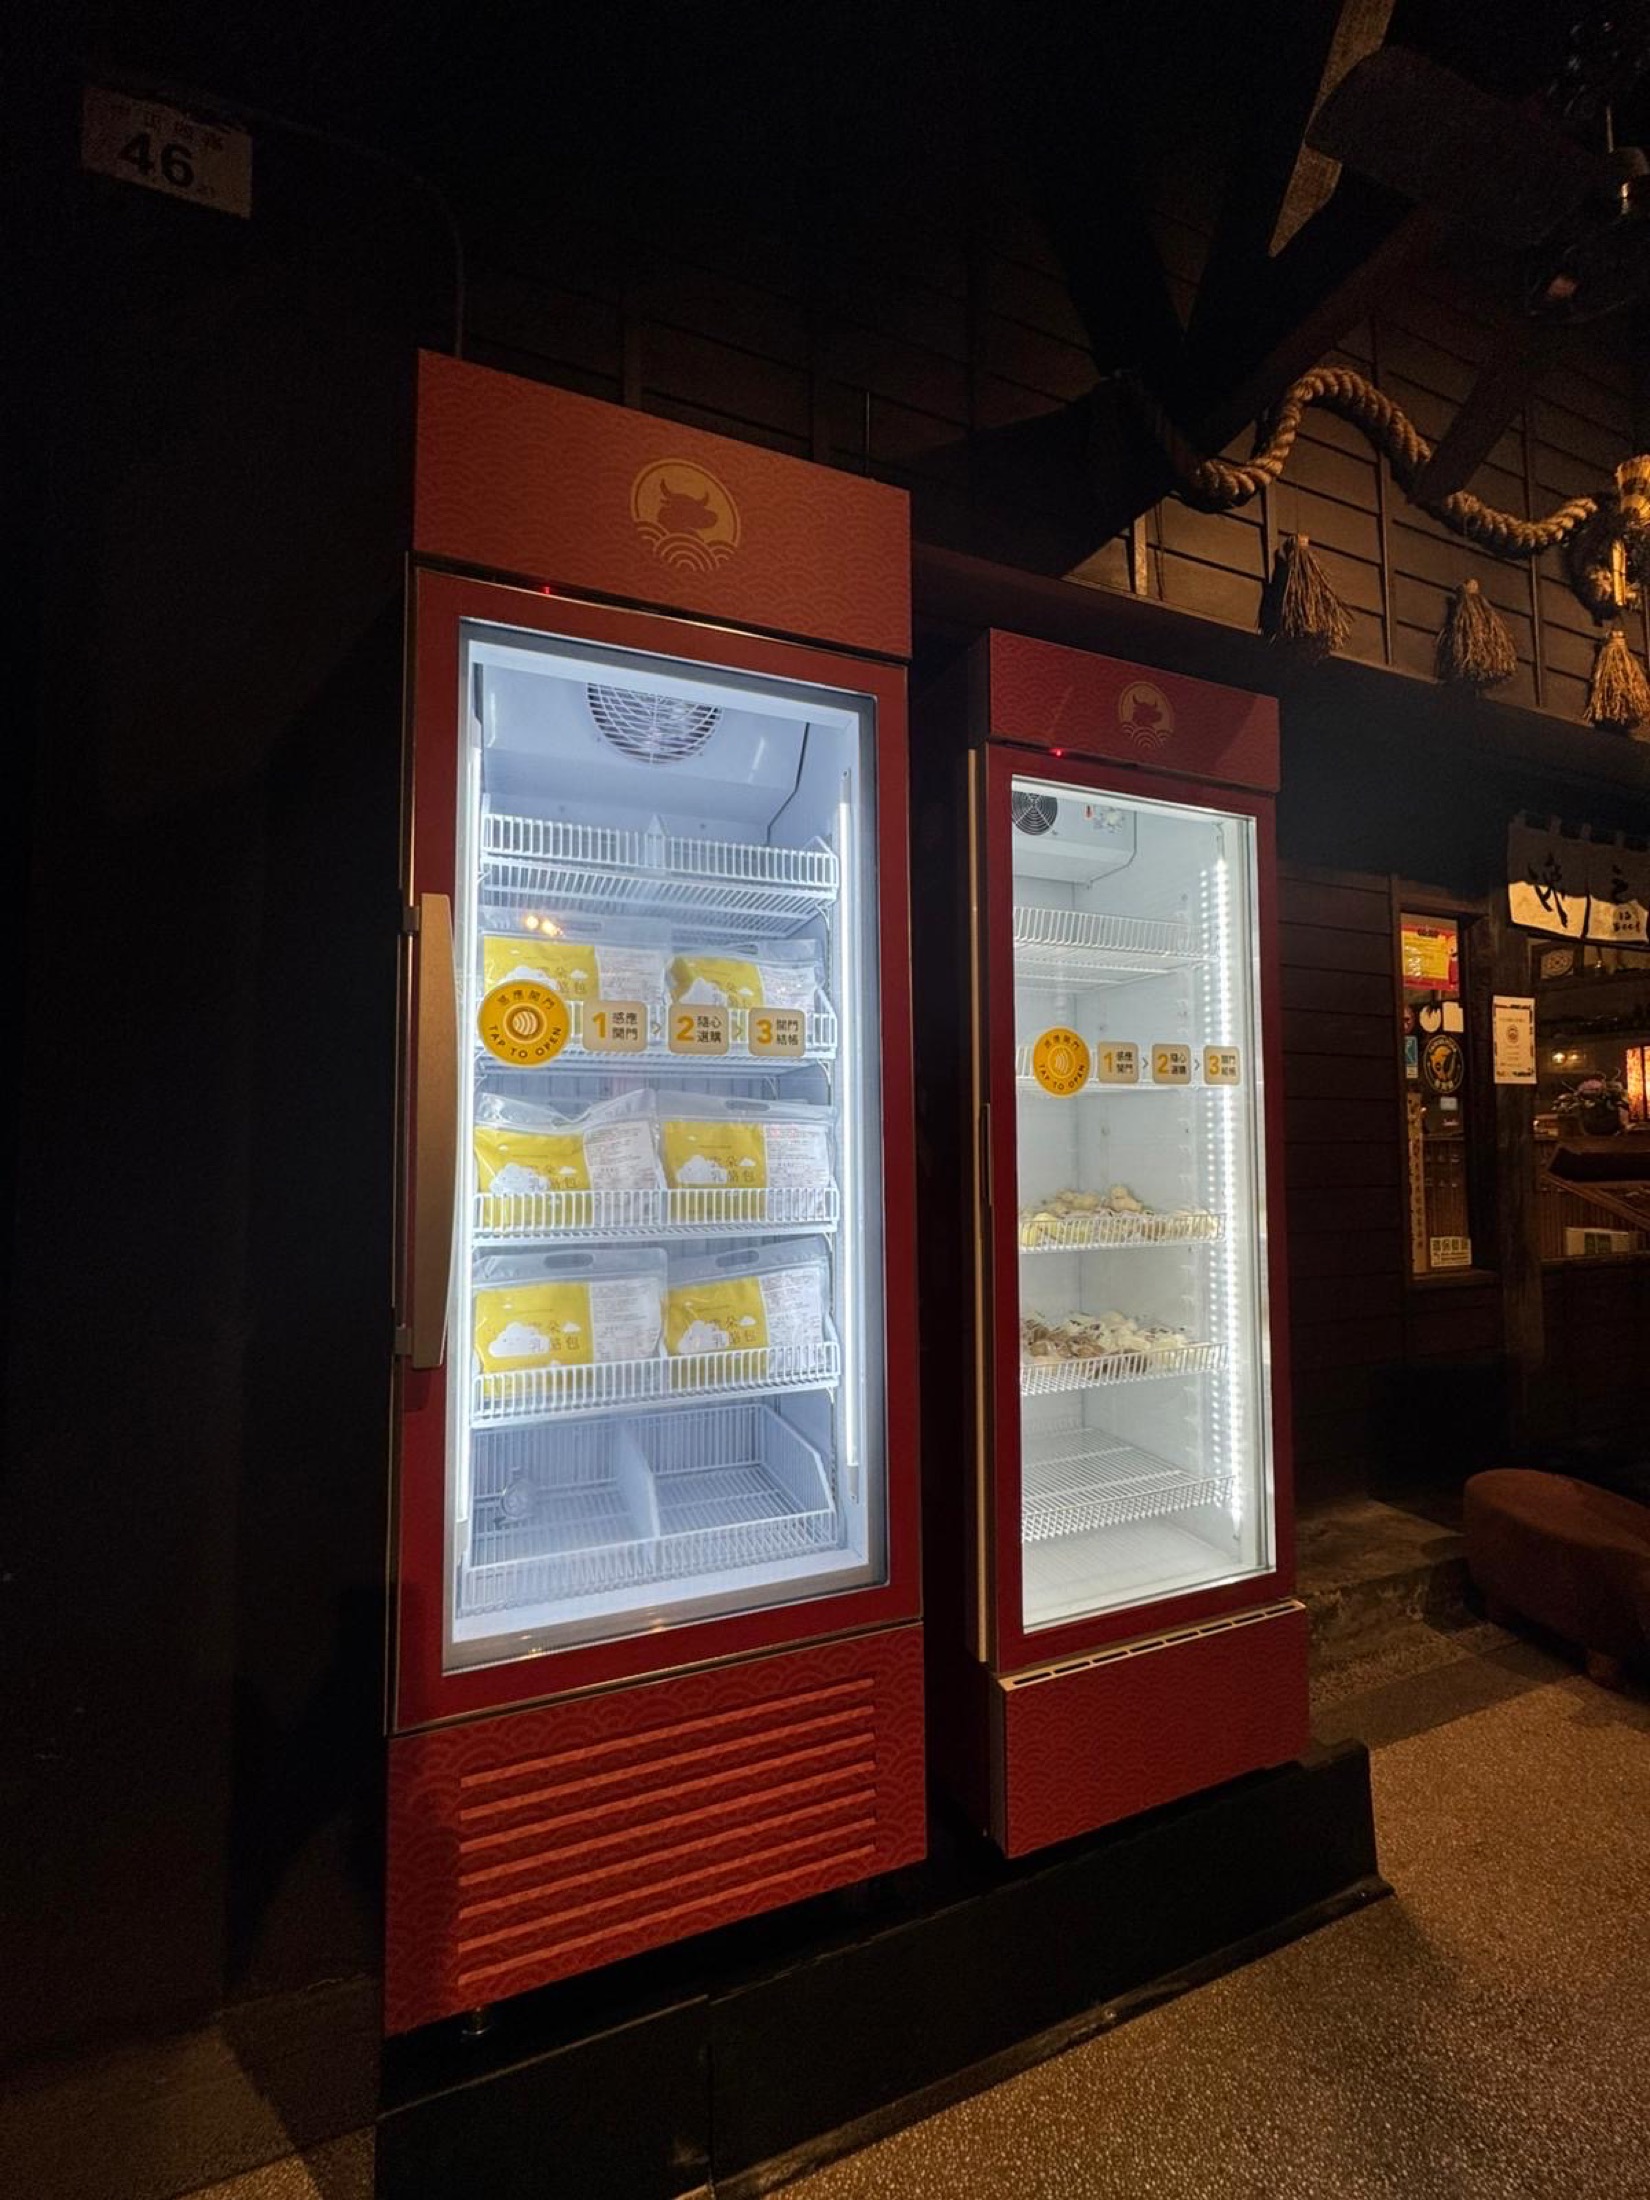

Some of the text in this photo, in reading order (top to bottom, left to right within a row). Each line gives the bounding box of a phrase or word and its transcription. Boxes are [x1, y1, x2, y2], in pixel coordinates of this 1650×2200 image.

[117, 133, 195, 188] 46
[592, 1011, 608, 1039] 1
[612, 1011, 638, 1026] 感應
[676, 1015, 695, 1042] 2
[697, 1015, 723, 1029] 隨心
[488, 1025, 562, 1059] TAP TO OPEN
[612, 1026, 639, 1041] 開門
[697, 1030, 722, 1044] 選購
[756, 1018, 773, 1045] 3
[1103, 1052, 1113, 1073] 1
[1157, 1053, 1169, 1074] 2
[1209, 1055, 1220, 1075] 3
[1053, 1080, 1065, 1090] TO
